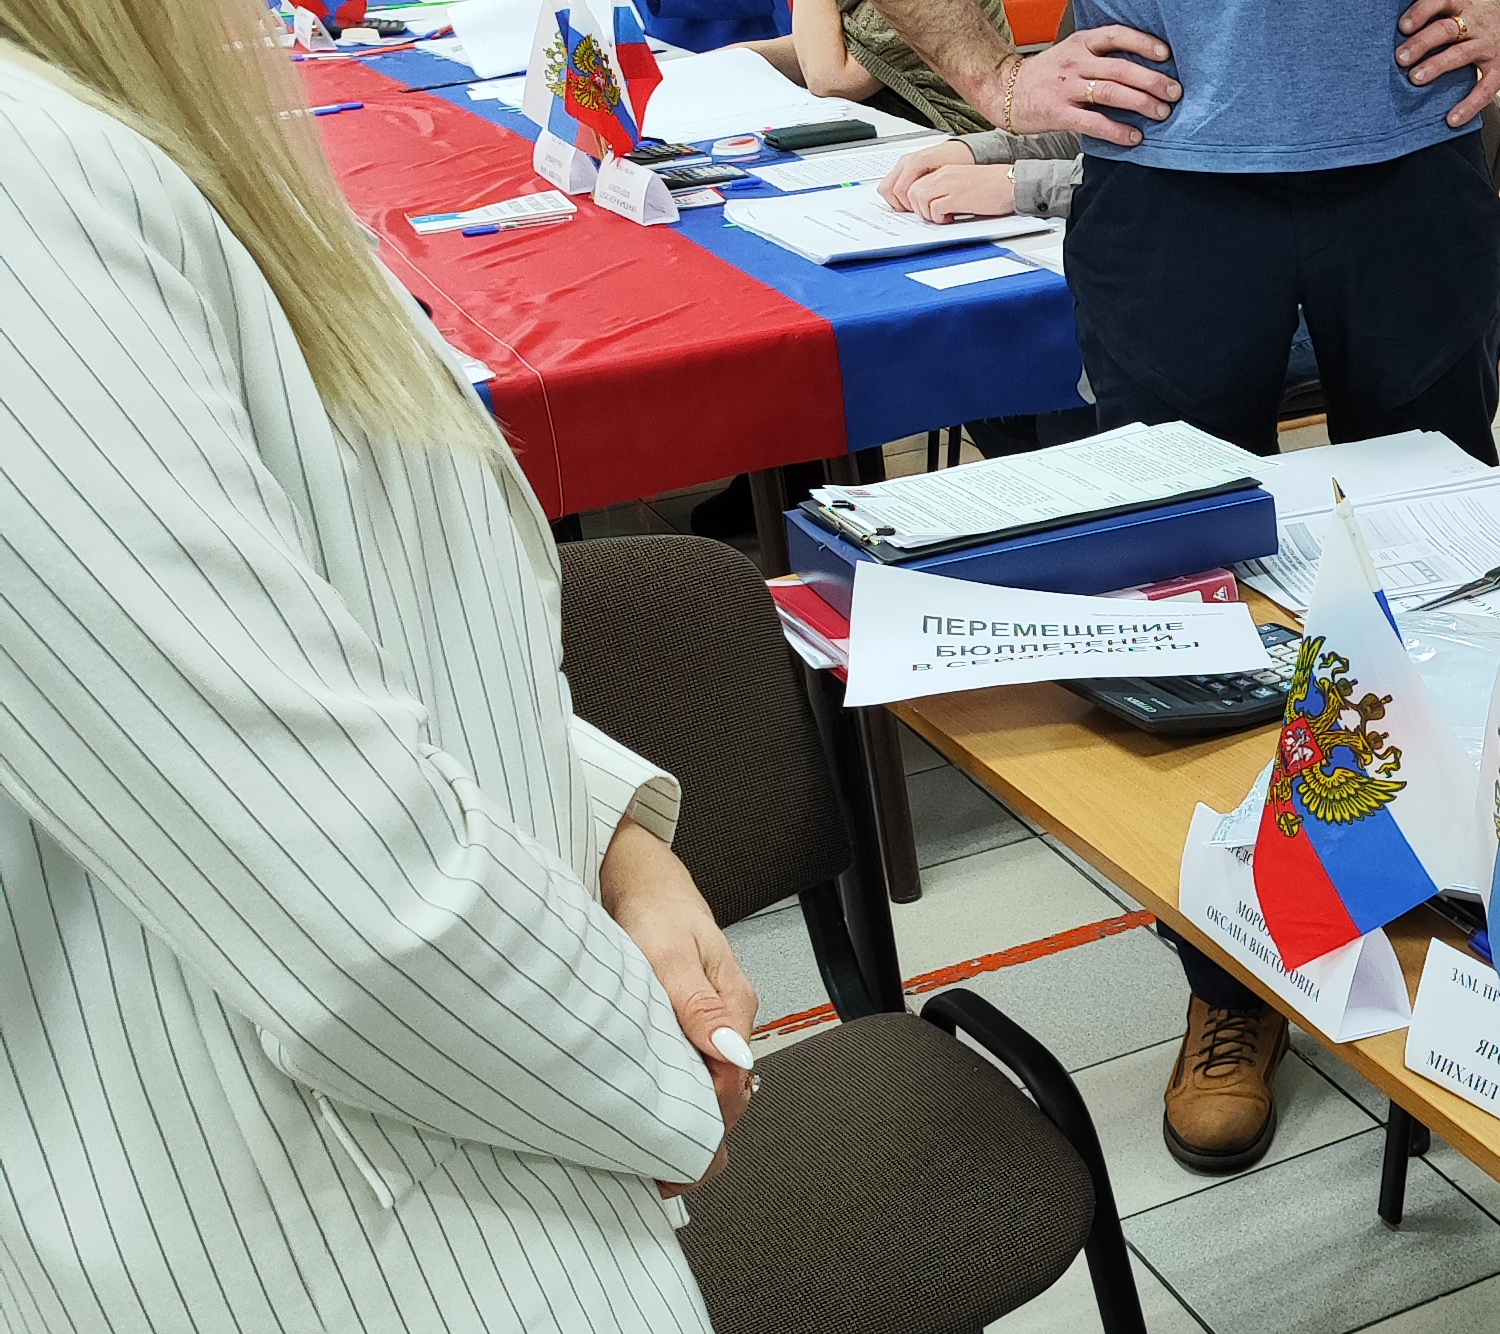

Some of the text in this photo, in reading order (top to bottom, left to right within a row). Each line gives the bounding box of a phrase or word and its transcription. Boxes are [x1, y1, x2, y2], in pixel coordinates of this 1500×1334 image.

[922, 614, 1185, 637] ПЕРЕМЕЩЕНИЕ
[936, 633, 1174, 657] БЮЛЛЕТЕНЕЙ
[1202, 904, 1324, 1002] ОКСАНА ВИКТОРОВНА
[1448, 966, 1482, 994] ЗАМ.
[1423, 1049, 1500, 1100] МИХАИЛ
